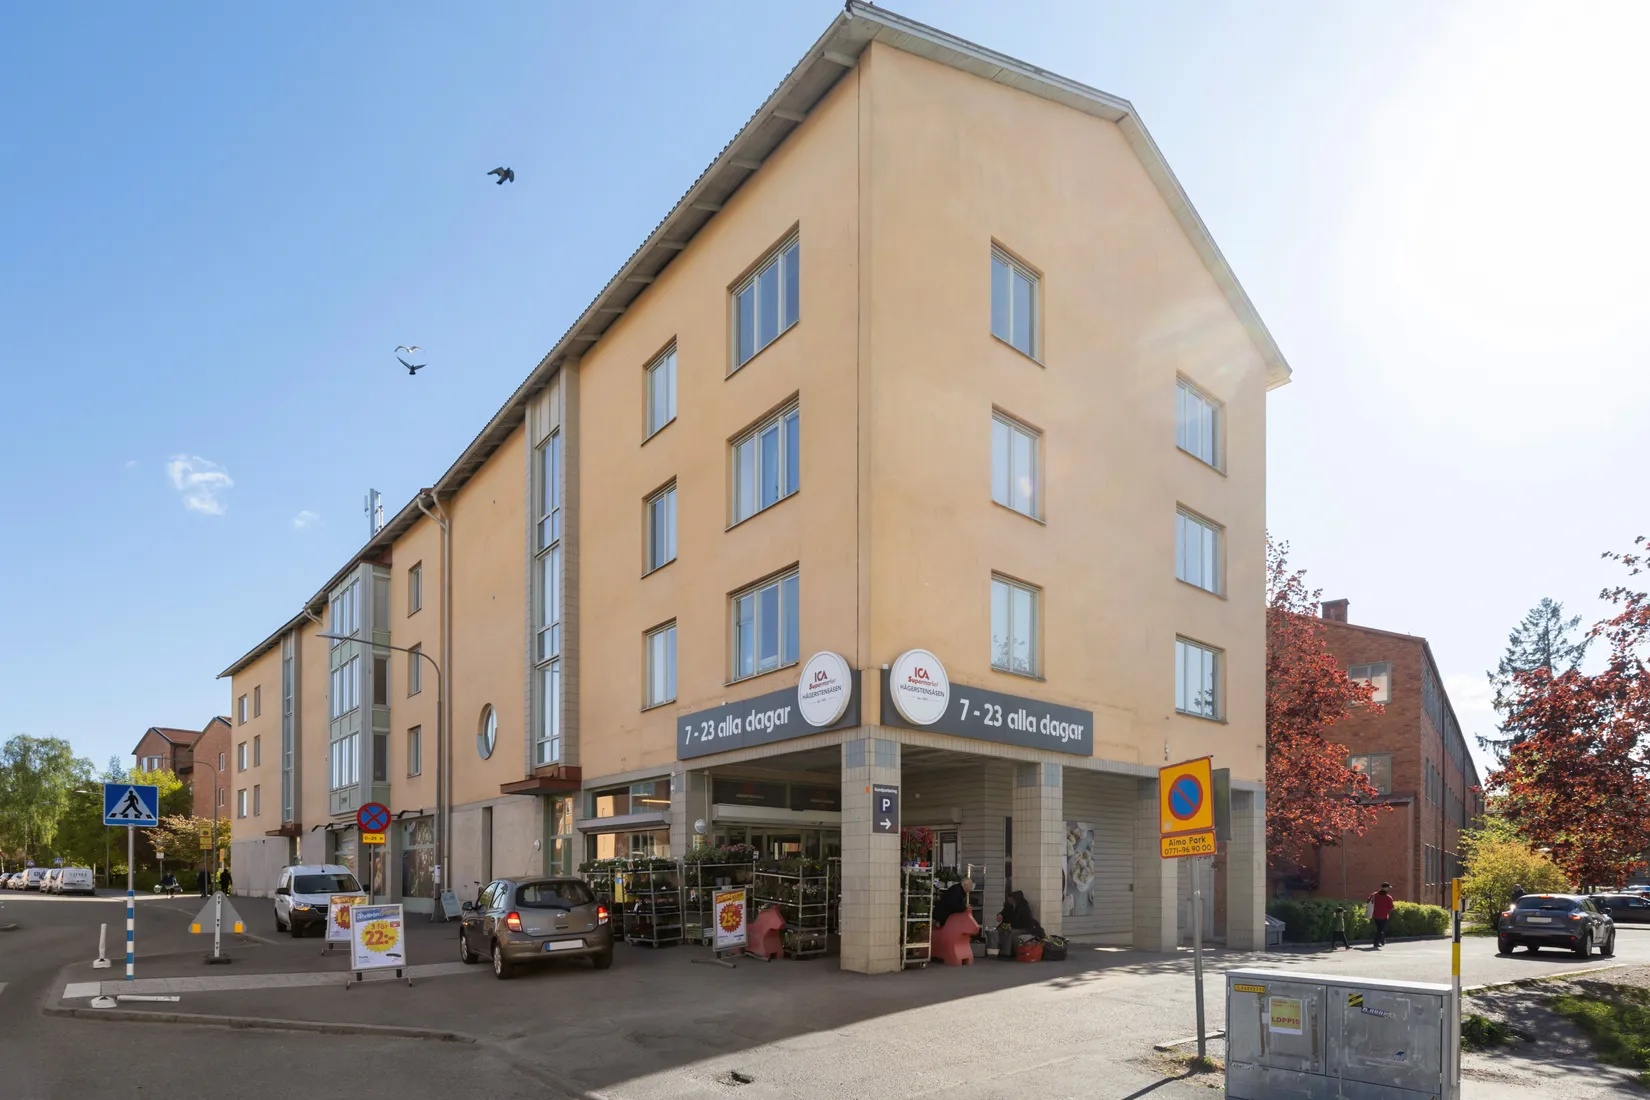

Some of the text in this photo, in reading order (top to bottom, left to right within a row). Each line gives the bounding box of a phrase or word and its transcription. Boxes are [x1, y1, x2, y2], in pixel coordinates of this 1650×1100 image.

[814, 670, 828, 682] ICA
[914, 667, 930, 680] ICA
[809, 677, 836, 690] Supermarket
[908, 676, 939, 687] Supermarket
[802, 684, 842, 700] HÄGERSTENSÅSEN
[900, 684, 945, 698] HÄGERSTENSÅSEN
[685, 725, 692, 745] 7
[701, 720, 714, 742] 23
[718, 715, 741, 738] alla
[746, 706, 791, 733] dagar
[960, 698, 970, 720] 7
[984, 703, 1002, 727] 23
[1008, 708, 1036, 732] alla
[1040, 714, 1084, 742] dagar
[882, 798, 890, 811] P
[1189, 836, 1206, 844] Park
[1271, 1016, 1300, 1025] LOPPIS
